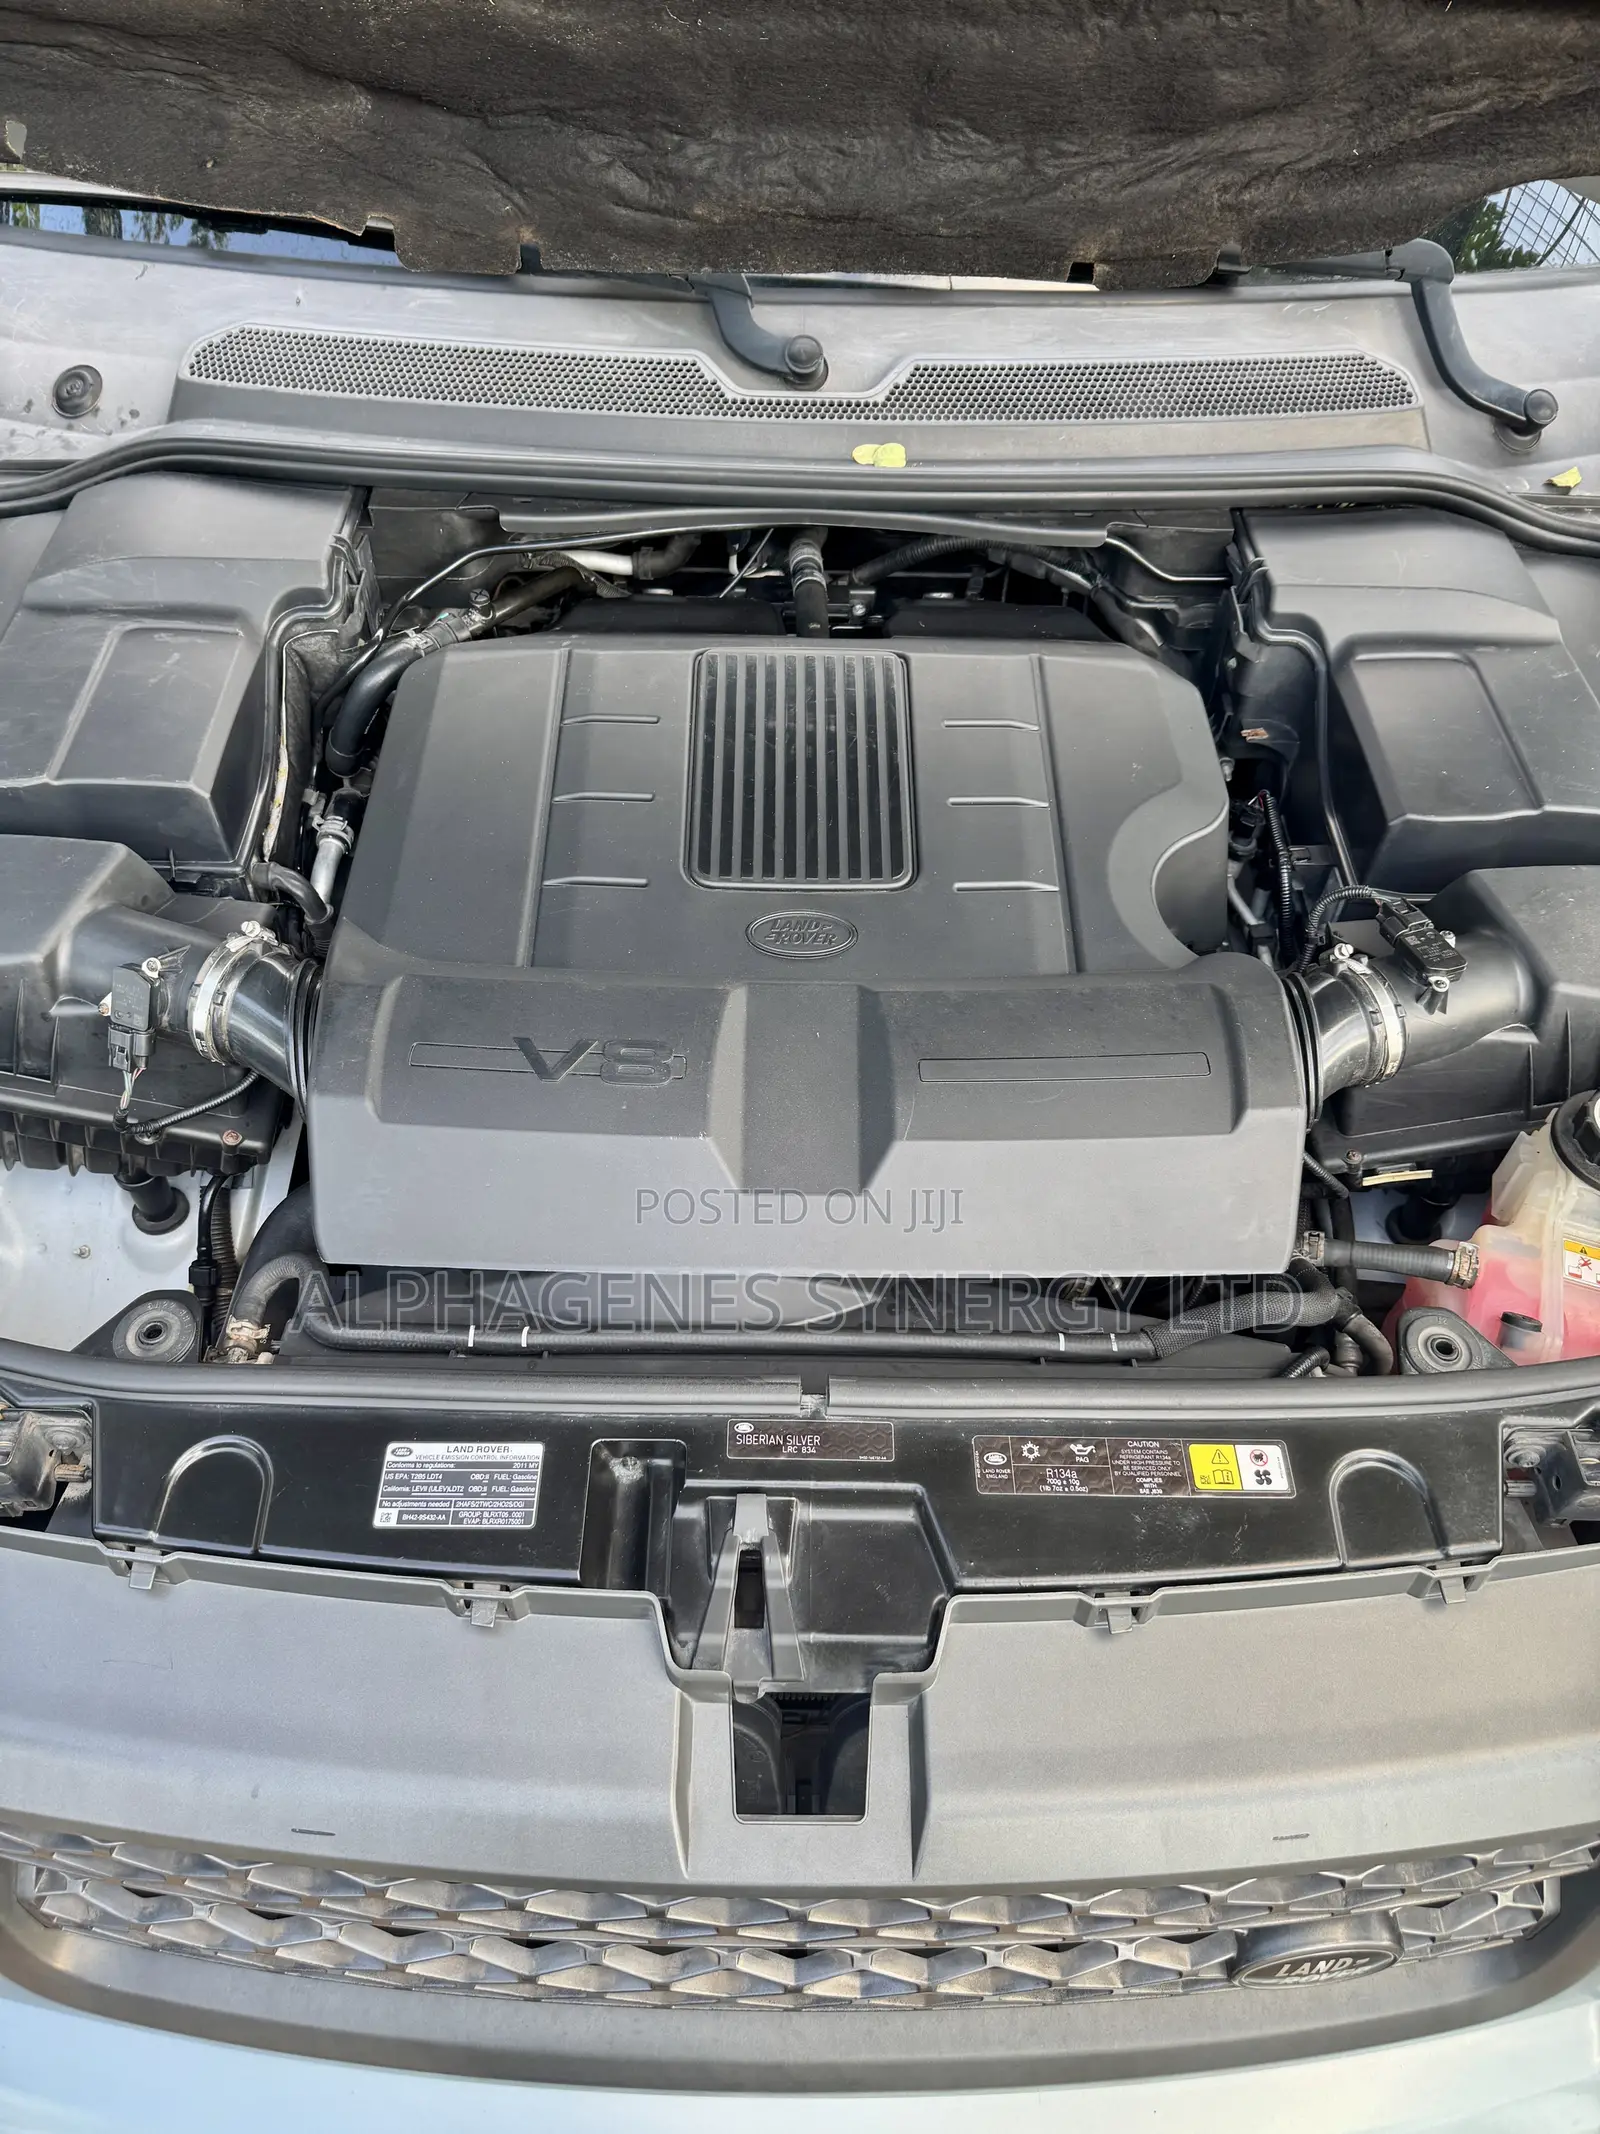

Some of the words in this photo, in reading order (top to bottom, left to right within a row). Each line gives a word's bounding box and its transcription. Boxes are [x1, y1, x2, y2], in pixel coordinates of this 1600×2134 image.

[770, 919, 822, 932] LAND
[775, 932, 838, 945] ROVER
[513, 1036, 673, 1087] V8
[736, 1434, 783, 1445] SIBERIAN
[786, 1435, 821, 1446] SILVER
[1127, 1440, 1160, 1448] CAUTION
[782, 1446, 798, 1454] LRC
[801, 1446, 816, 1454] 834
[423, 1462, 456, 1470] regulations:
[1046, 1468, 1078, 1479] R134a
[392, 1500, 427, 1508] adjustments
[1275, 1957, 1353, 1977] LAND
